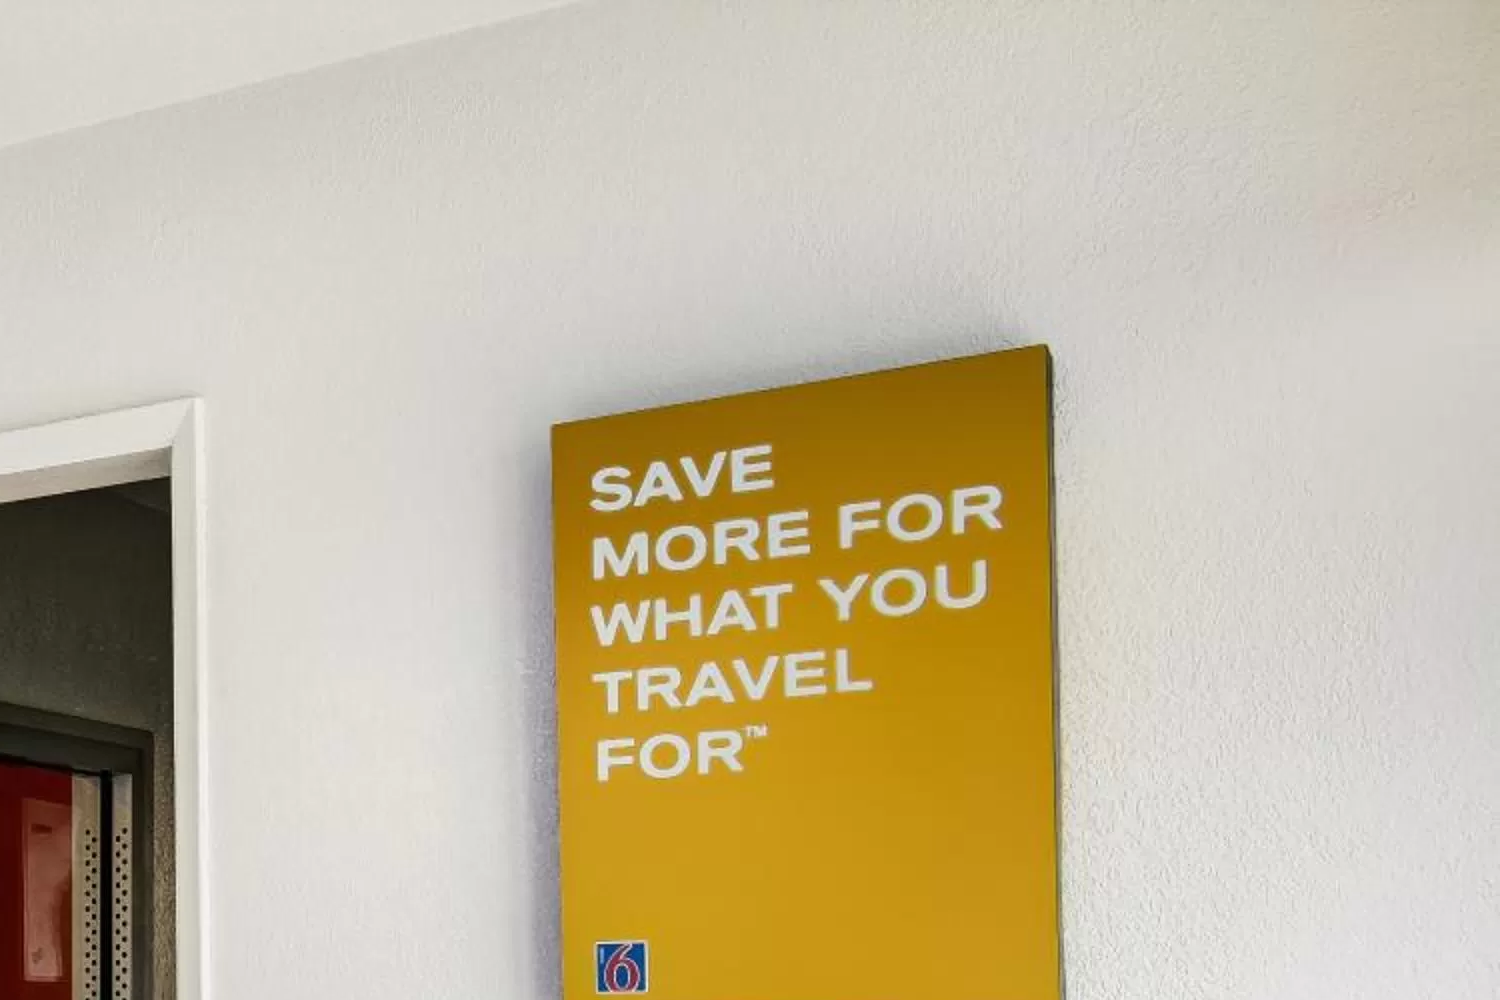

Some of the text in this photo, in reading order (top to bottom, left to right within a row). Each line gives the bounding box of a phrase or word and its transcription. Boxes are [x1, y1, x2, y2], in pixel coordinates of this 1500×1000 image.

[590, 444, 775, 512] SAVE
[592, 485, 1004, 580] MORE FOR
[591, 559, 988, 647] WHAT YOU
[592, 648, 873, 714] TRAVEL
